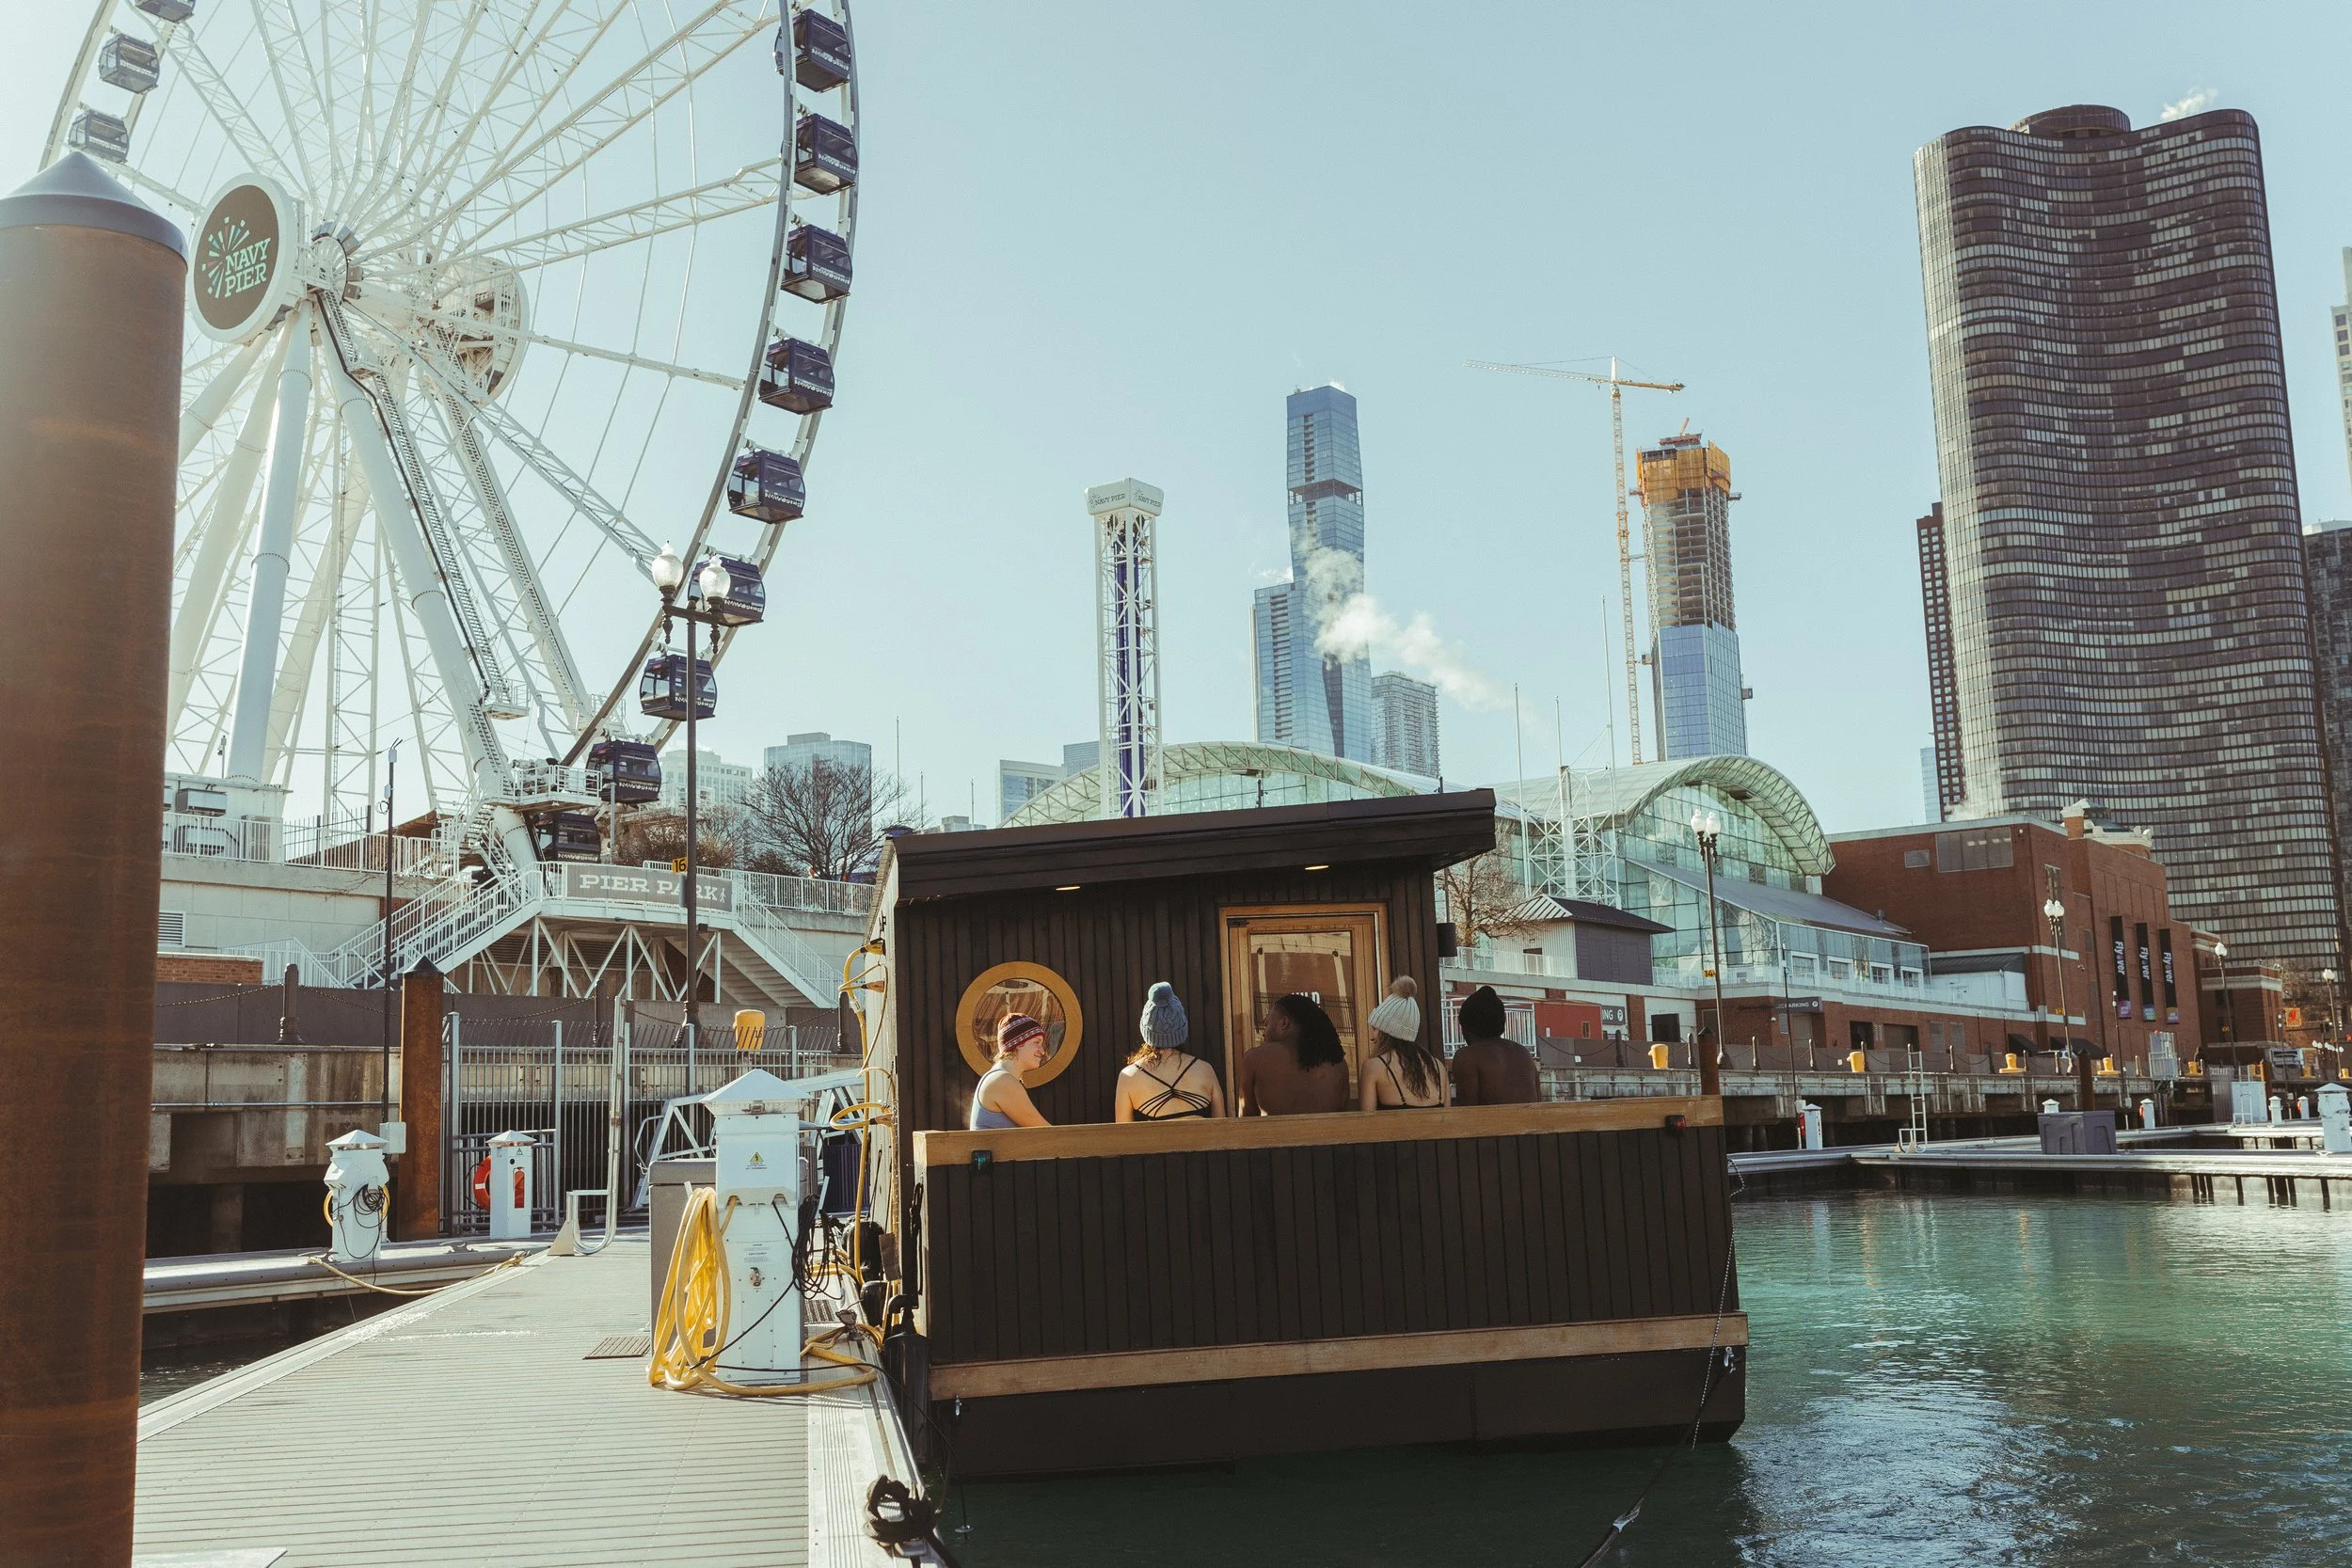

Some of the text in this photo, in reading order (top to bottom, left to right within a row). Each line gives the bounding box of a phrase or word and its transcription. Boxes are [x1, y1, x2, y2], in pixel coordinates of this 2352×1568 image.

[226, 237, 271, 276] NAVY
[225, 262, 267, 297] PIER
[1094, 493, 1126, 506] NAVY PIER
[1137, 495, 1162, 508] NAVY PIER
[674, 859, 687, 872] 16
[580, 874, 650, 893] PIER
[2114, 941, 2125, 974] Flyover
[1601, 1009, 1613, 1021] ING
